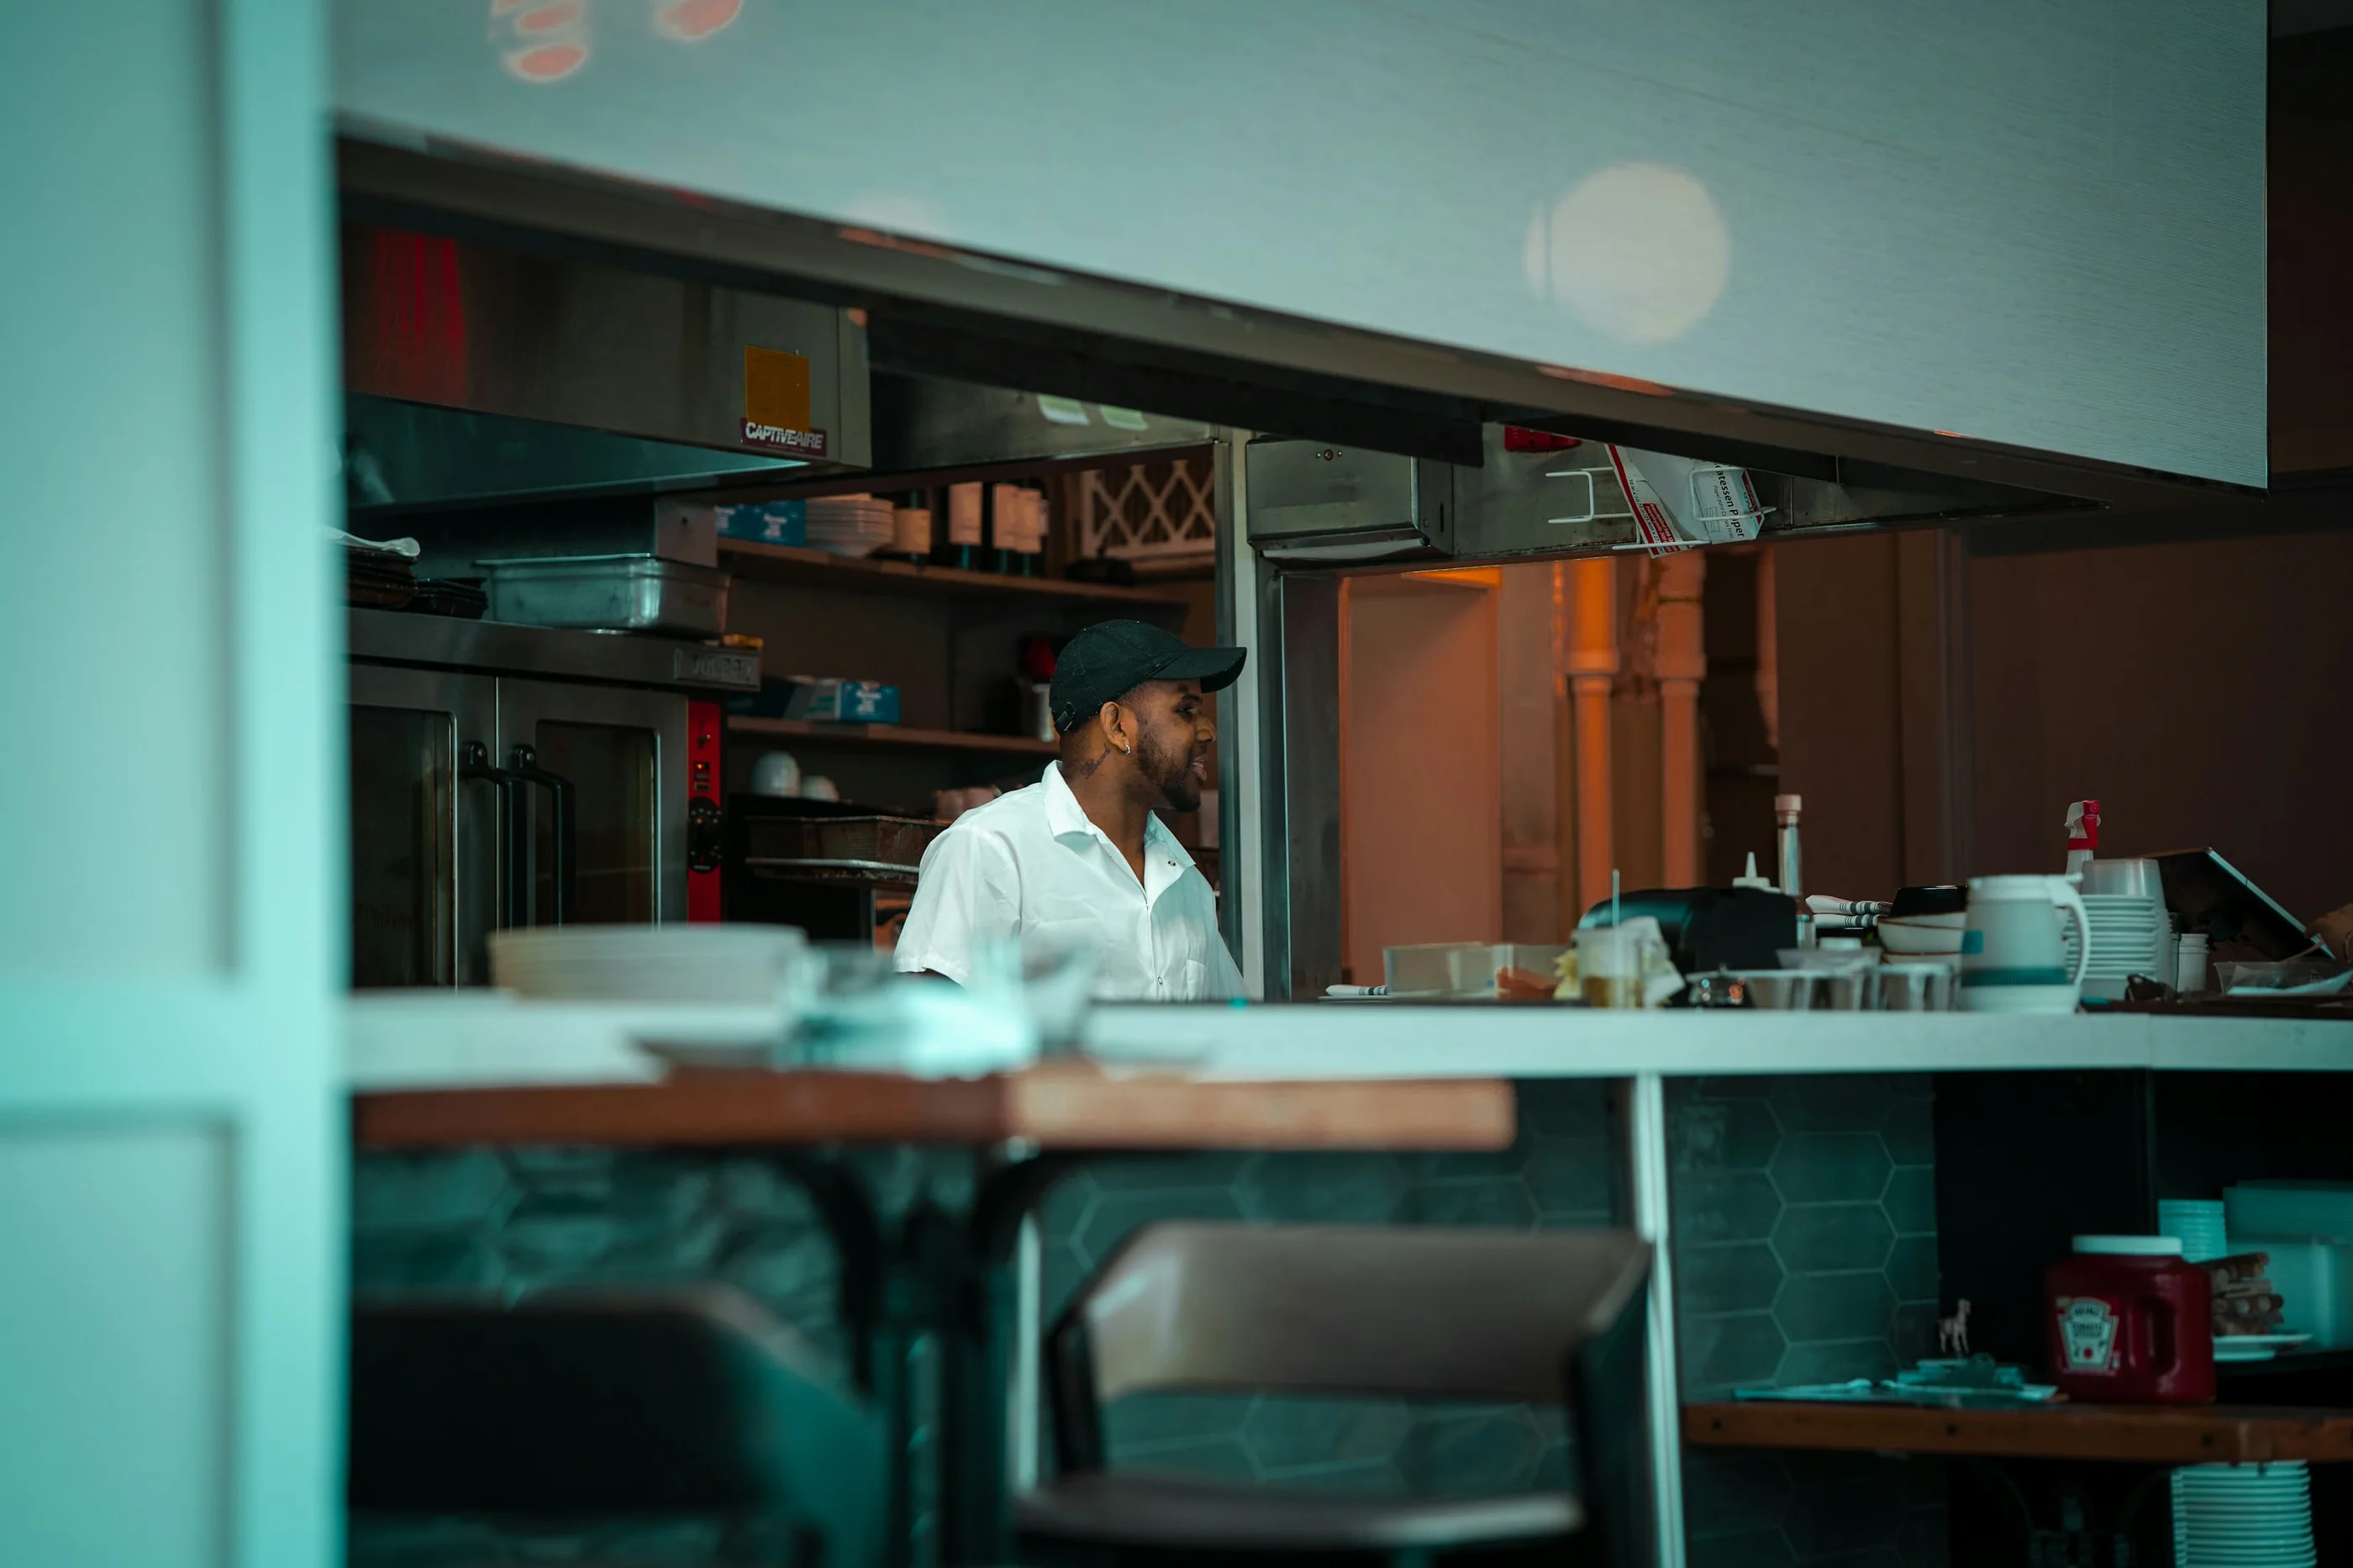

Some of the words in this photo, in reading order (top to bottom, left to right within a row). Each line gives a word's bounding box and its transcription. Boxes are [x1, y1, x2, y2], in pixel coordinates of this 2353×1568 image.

[745, 422, 824, 449] CAPTIVEAIRE
[1714, 463, 1734, 507] atessen
[1721, 510, 1731, 528] Cnes
